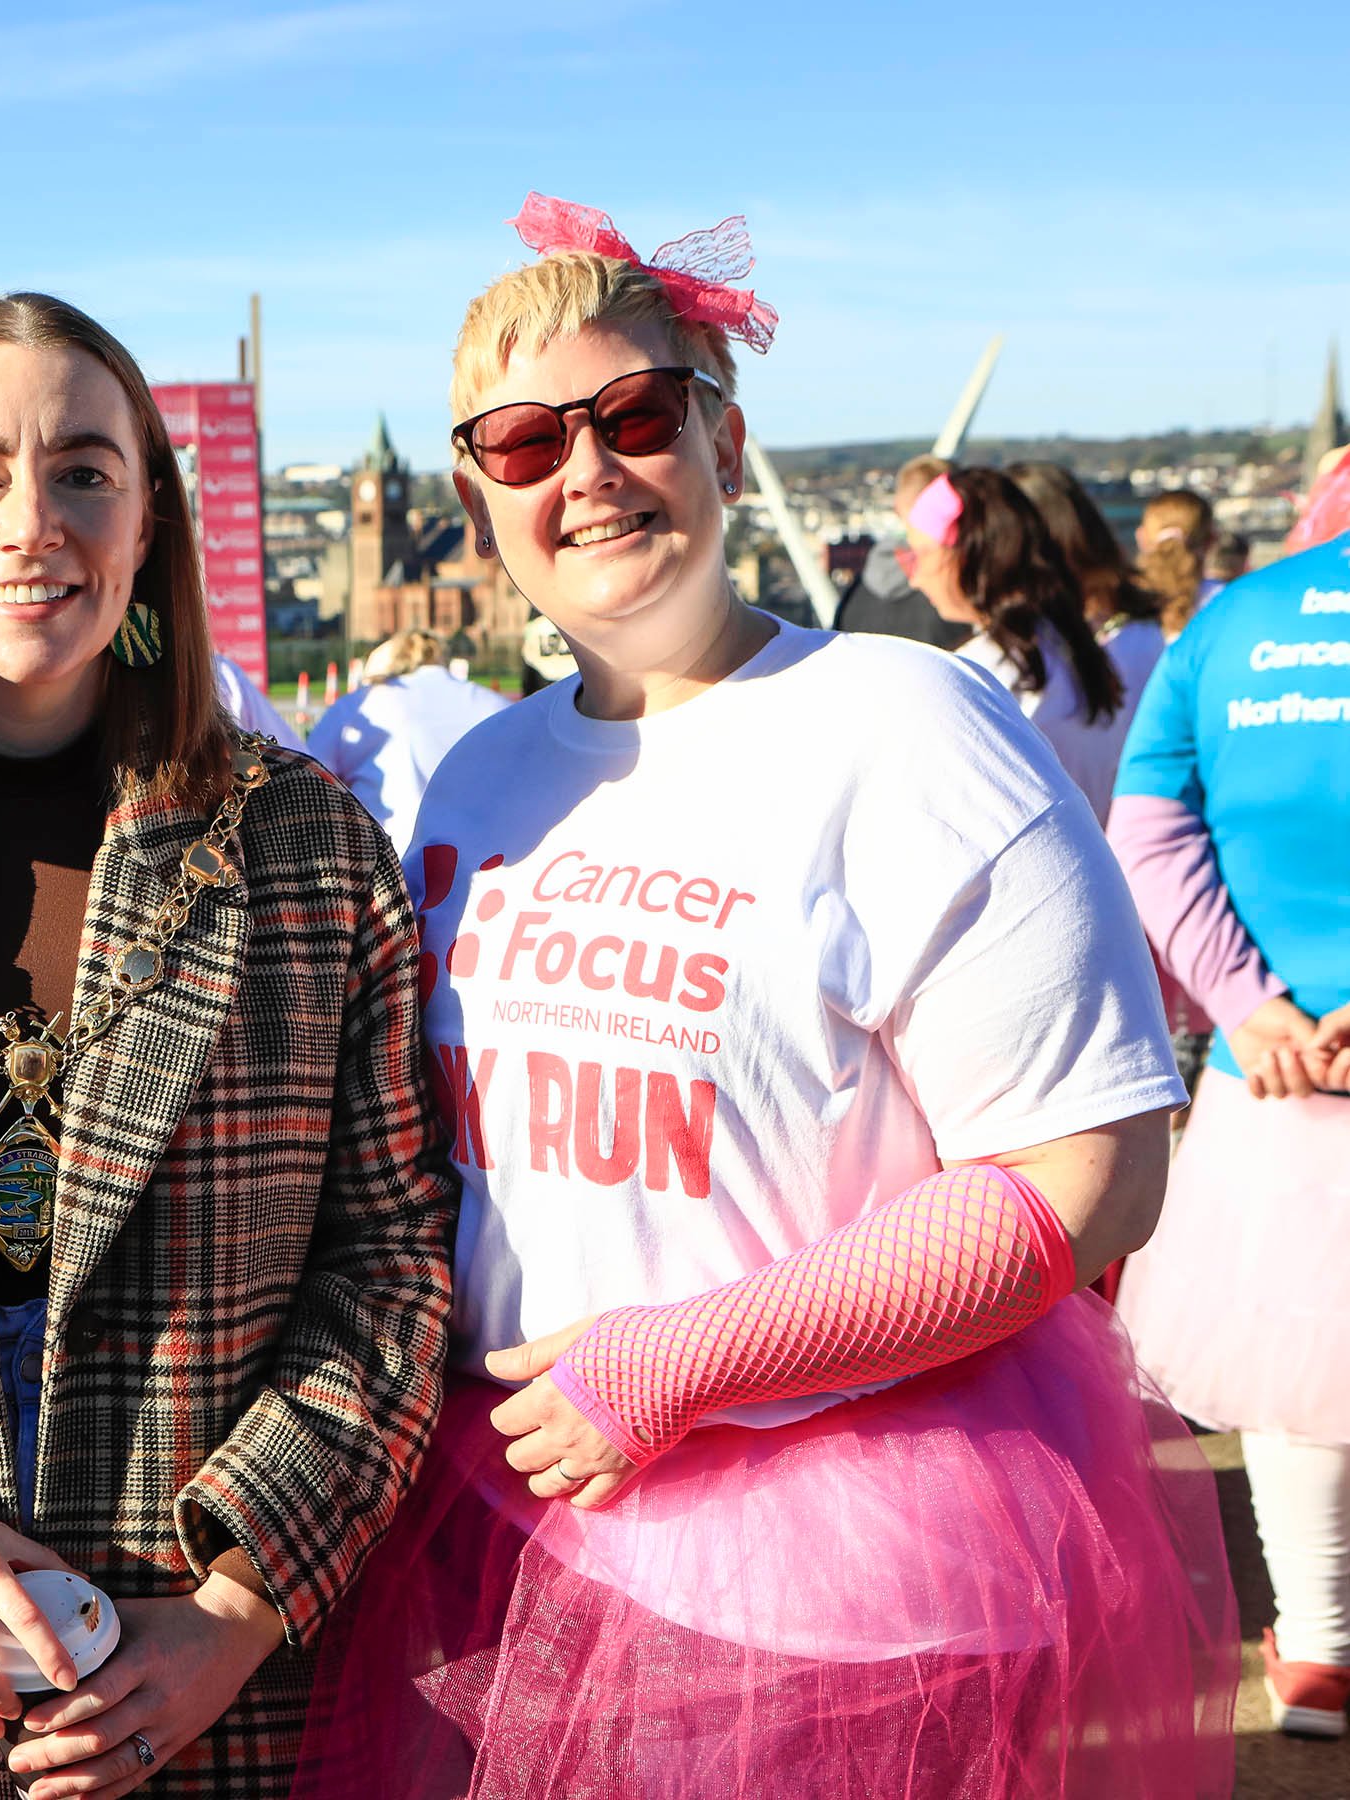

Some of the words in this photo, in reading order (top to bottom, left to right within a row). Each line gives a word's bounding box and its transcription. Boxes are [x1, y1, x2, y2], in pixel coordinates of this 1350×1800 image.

[1249, 640, 1350, 672] Cance
[532, 850, 756, 929] Cancer
[499, 911, 729, 1012] Focus
[493, 1000, 601, 1033] NORTHERN
[607, 1012, 721, 1054] IRELAND
[527, 1051, 717, 1200] RUN
[16, 1150, 58, 1168] STRABANE
